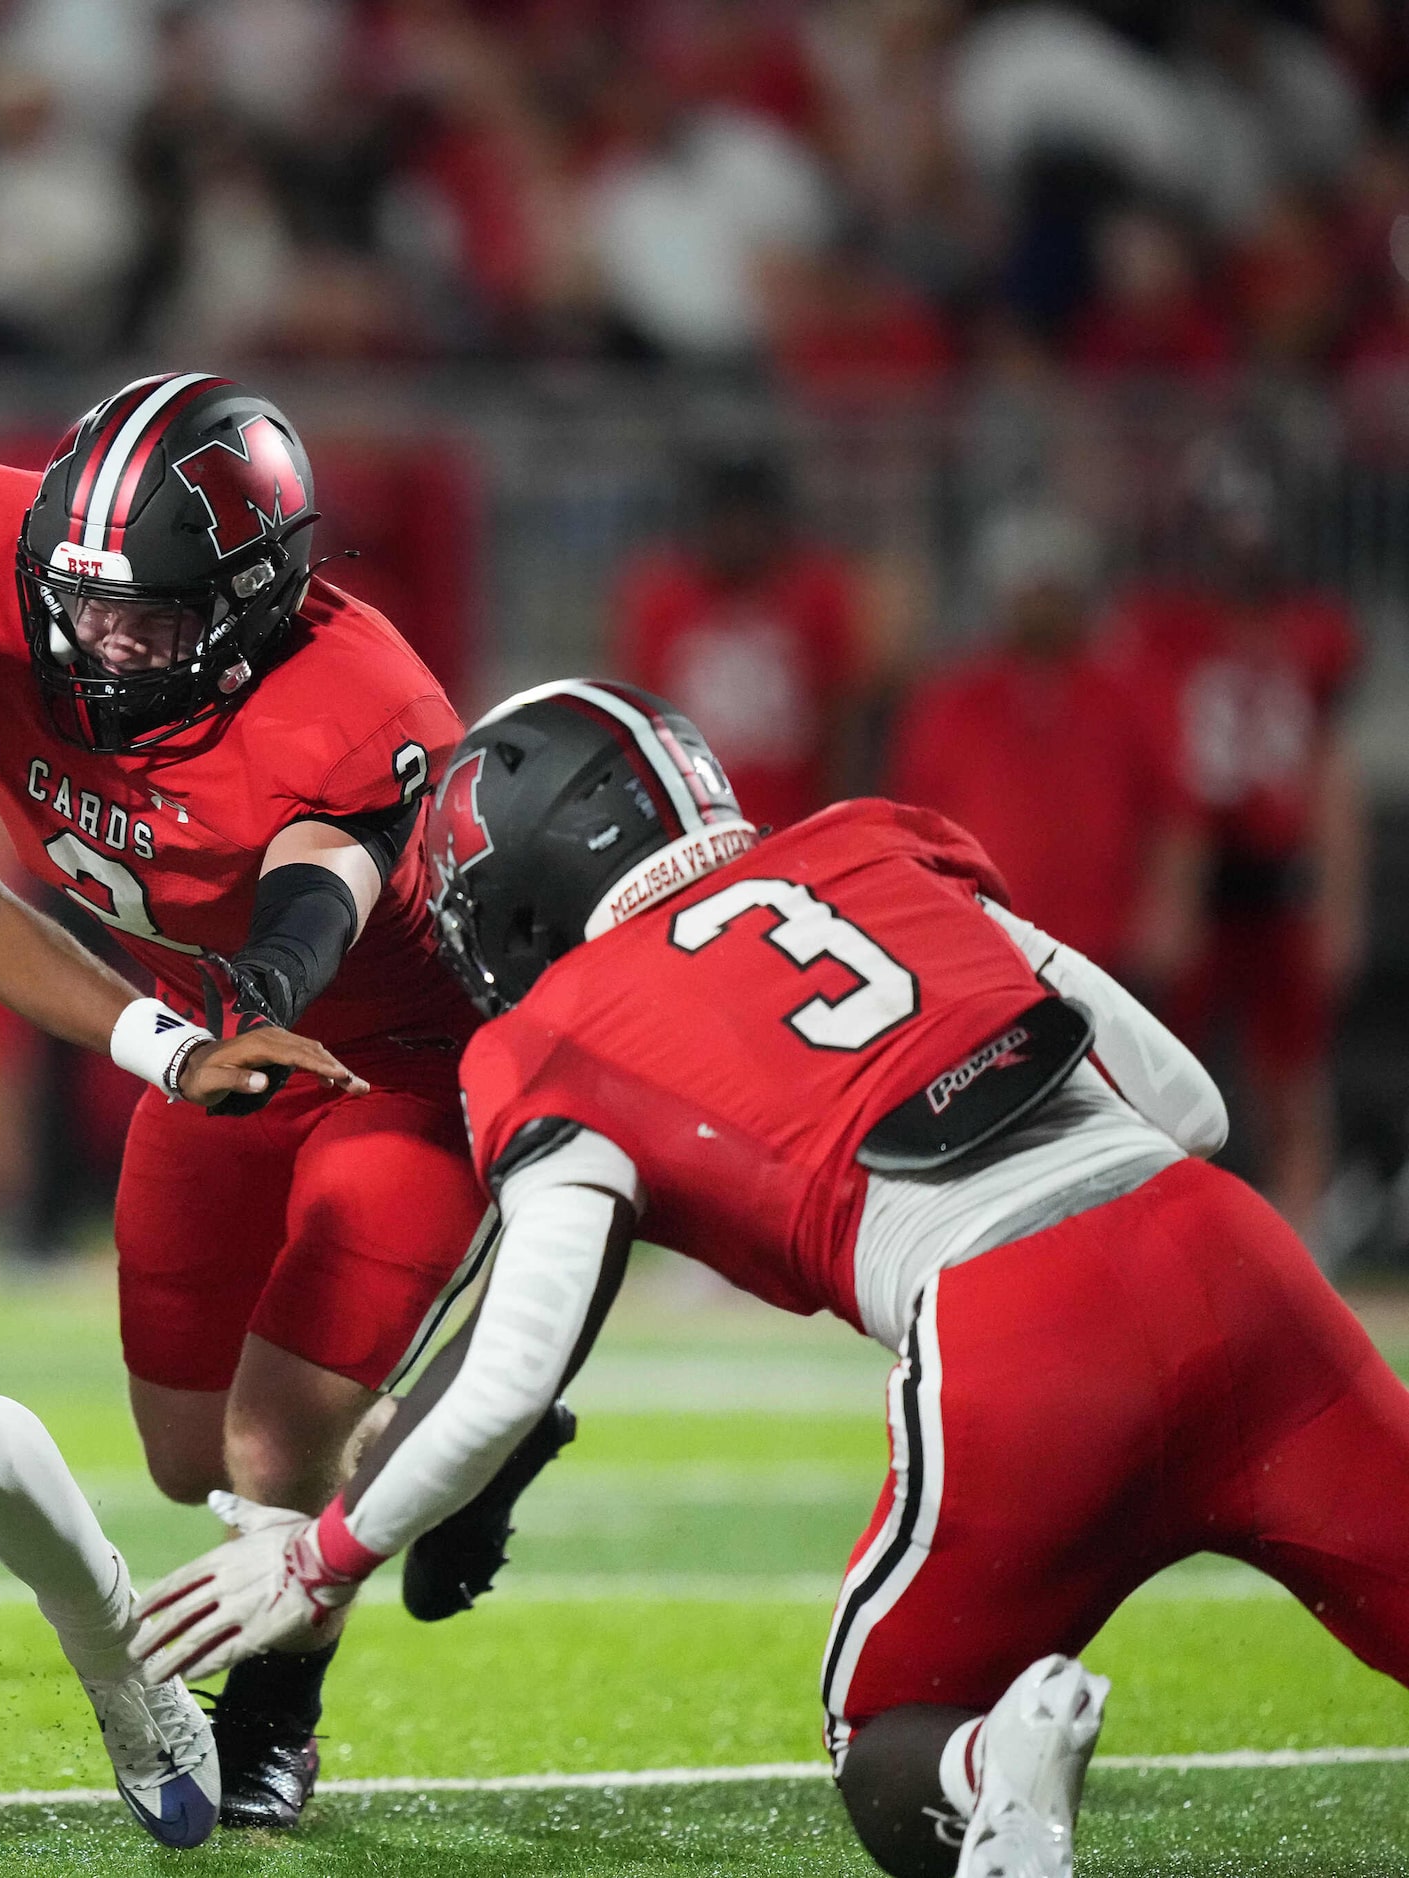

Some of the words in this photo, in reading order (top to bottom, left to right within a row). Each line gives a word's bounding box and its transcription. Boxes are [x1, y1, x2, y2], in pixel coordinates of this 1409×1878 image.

[171, 413, 309, 560] M
[27, 757, 155, 861] CARDS
[393, 739, 434, 806] 2
[43, 827, 205, 957] 2
[610, 855, 685, 927] MELISSA
[667, 877, 921, 1053] 3
